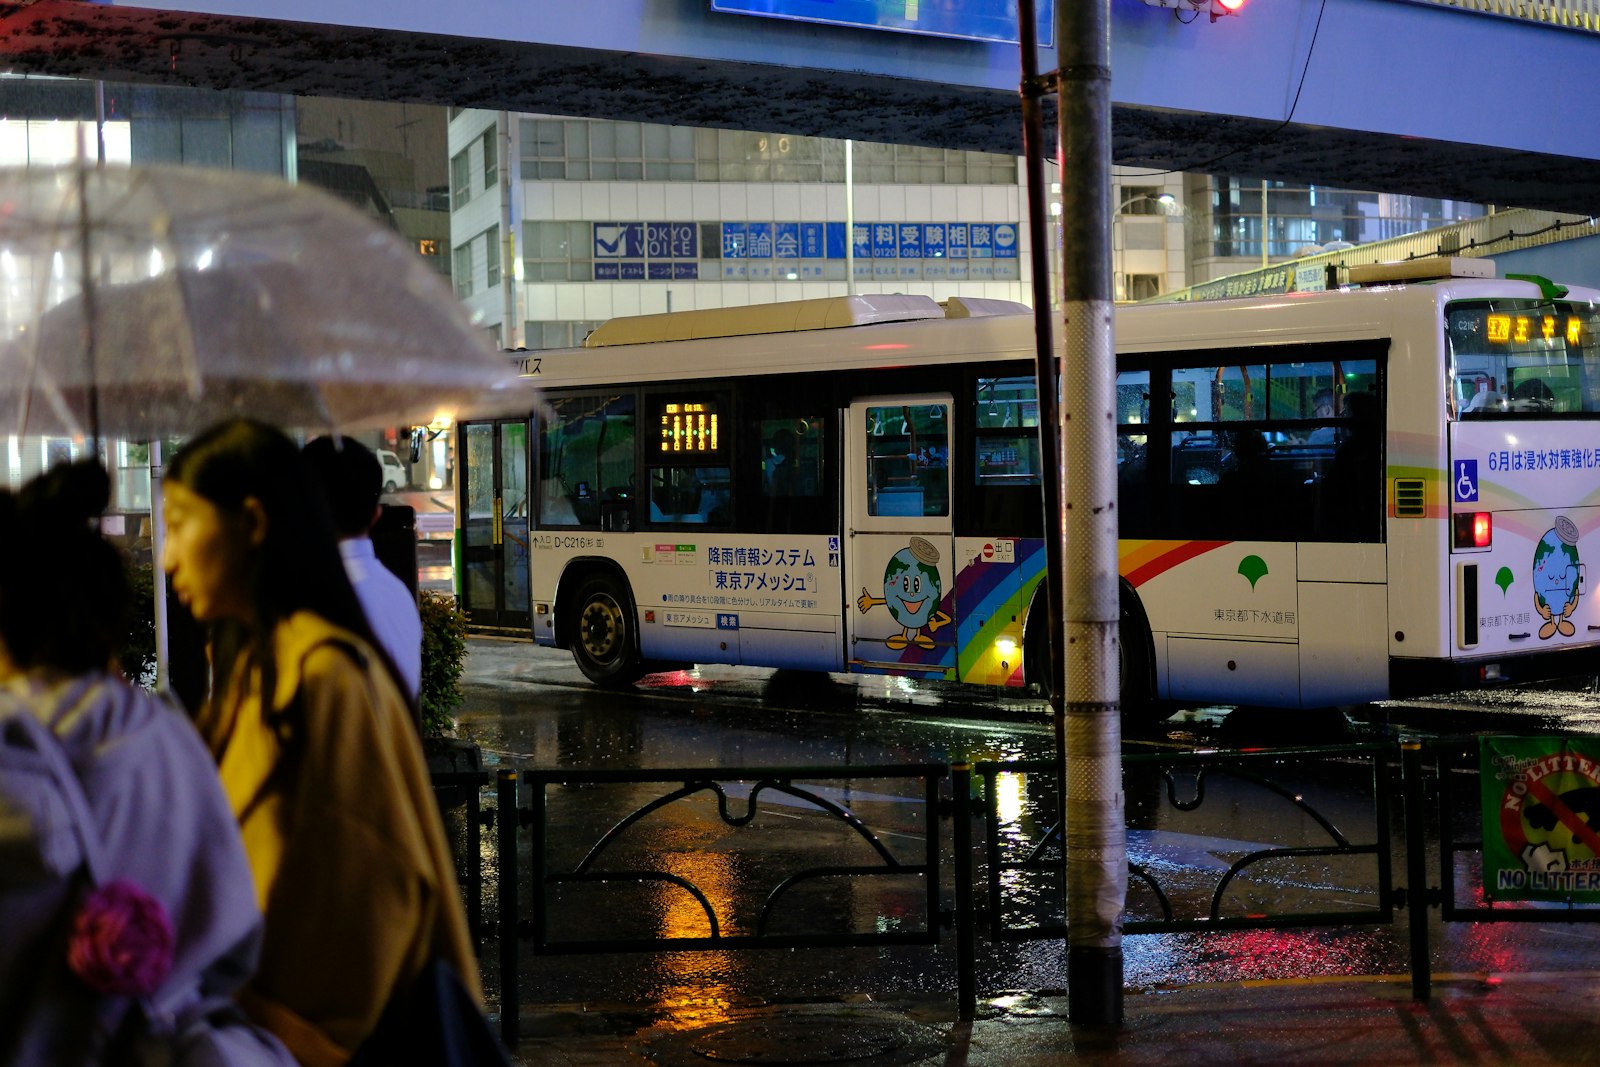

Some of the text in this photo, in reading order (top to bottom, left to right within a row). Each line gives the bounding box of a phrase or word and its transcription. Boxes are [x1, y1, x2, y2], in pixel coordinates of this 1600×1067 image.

[634, 226, 692, 240] TOKYO
[852, 225, 991, 245] 無料受験相談
[635, 241, 691, 256] VOICE
[723, 232, 797, 257] 現論会
[874, 247, 945, 257] 0120-086-37
[511, 358, 542, 375] バス
[995, 541, 1012, 553] 出口
[708, 546, 816, 567] 降雨情報システム
[665, 613, 738, 627] 東京アメッシュ 検索
[1214, 608, 1296, 624] 東京都下水道局
[1480, 612, 1531, 628] 東京都下水道局
[1505, 781, 1527, 811] NO
[1498, 869, 1526, 890] NO
